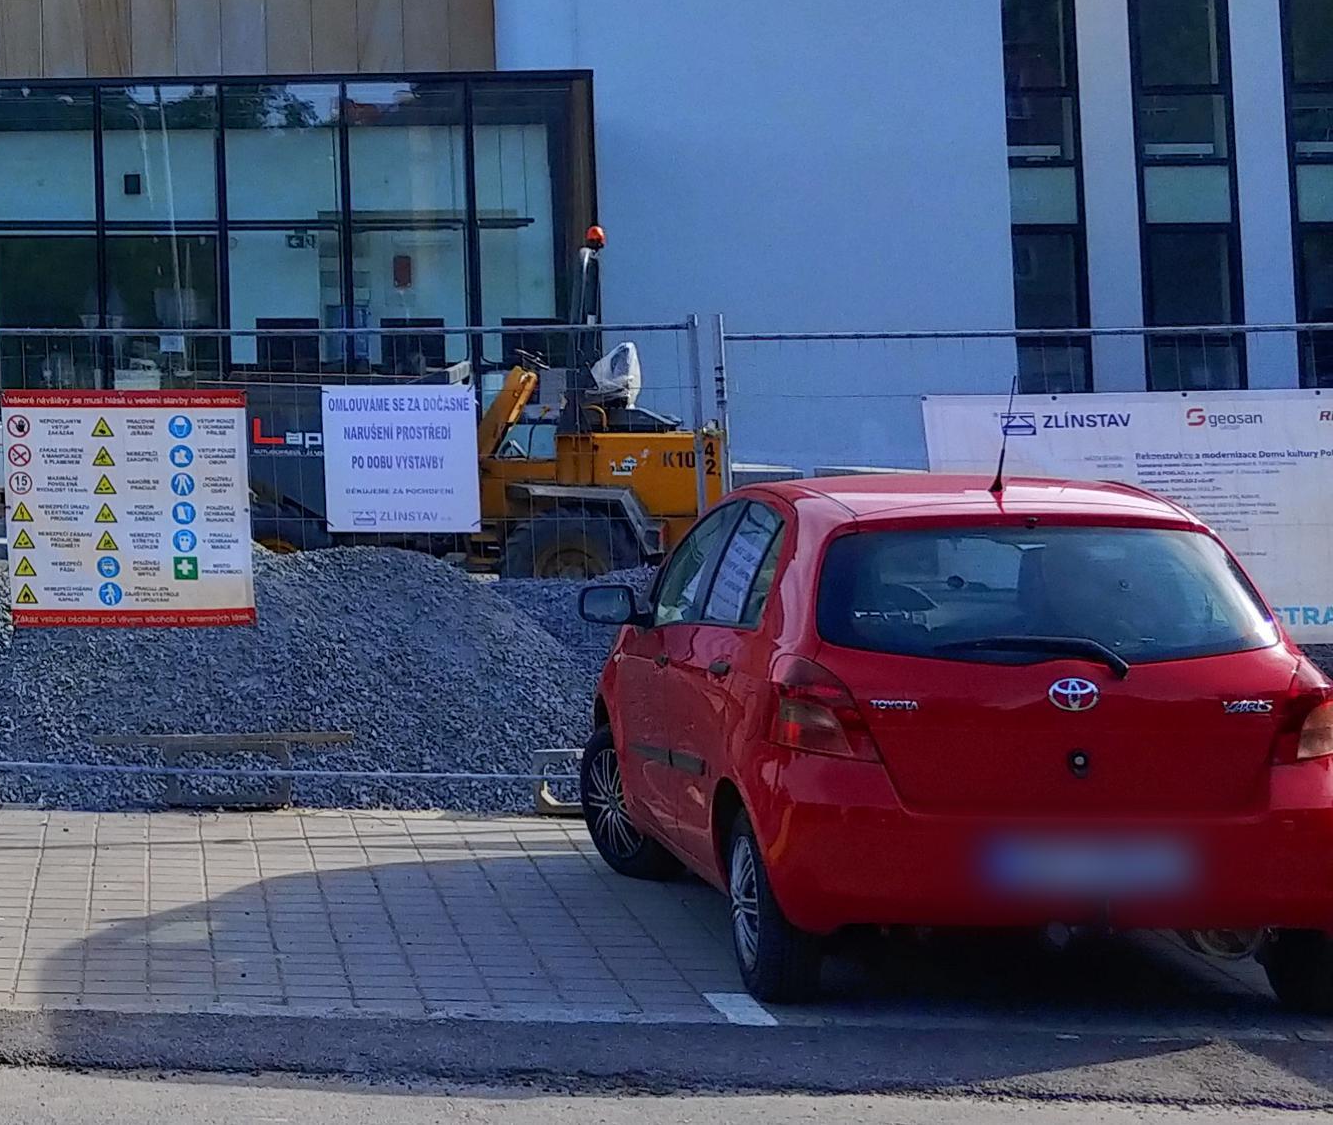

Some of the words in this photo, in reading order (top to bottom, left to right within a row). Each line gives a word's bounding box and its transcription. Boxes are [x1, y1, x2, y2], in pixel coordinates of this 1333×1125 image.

[393, 397, 406, 412] SE
[407, 398, 421, 412] ZA
[1042, 411, 1131, 428] ZLÍNSTAV
[1208, 412, 1263, 430] geosan
[1201, 450, 1257, 459] modernizace
[1258, 450, 1285, 458] Domu
[1287, 449, 1319, 459] kultury
[351, 455, 365, 470] PO
[367, 455, 393, 470] DOBU
[14, 475, 28, 486] 15
[869, 699, 919, 710] TOYOTA
[1222, 699, 1274, 713] YARIS
